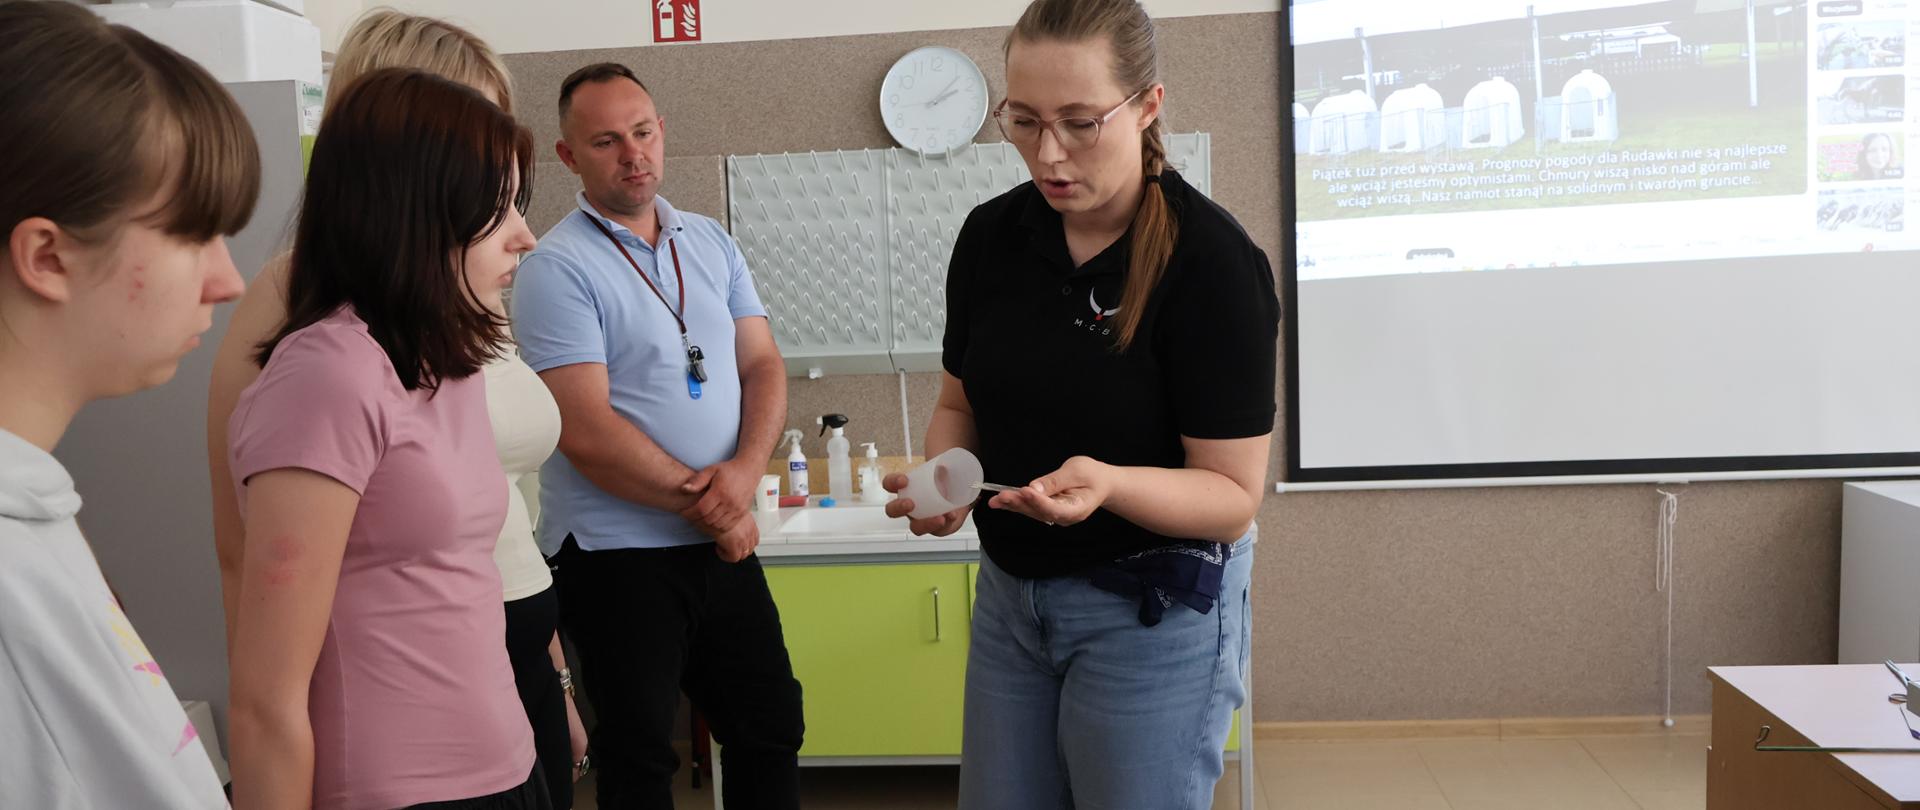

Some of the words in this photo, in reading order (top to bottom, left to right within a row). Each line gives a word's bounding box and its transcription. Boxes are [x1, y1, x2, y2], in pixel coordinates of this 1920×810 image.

[931, 56, 943, 72] 12
[899, 75, 914, 90] 10
[890, 94, 900, 108] 9
[895, 113, 904, 128] 8
[927, 132, 936, 148] 6
[1312, 168, 1353, 182] Piątek
[1380, 163, 1416, 178] przed
[1482, 158, 1541, 171] Prognozy
[1545, 153, 1594, 168] pogody
[1598, 151, 1618, 164] dla
[1622, 148, 1677, 163] Rudawki
[1682, 147, 1702, 158] nie
[1706, 148, 1721, 159] są
[1725, 143, 1787, 158] najlepsze
[1328, 182, 1348, 194] ale
[1351, 180, 1387, 193] wciąż
[1391, 176, 1447, 191] jesteśmy
[1450, 171, 1535, 188] optymistami.
[1538, 169, 1590, 181] Chmury
[1594, 166, 1629, 179] wiszą
[1633, 163, 1667, 176] nisko
[1671, 161, 1696, 174] nad
[1699, 159, 1746, 175] górami
[1751, 158, 1770, 170] ale
[1336, 195, 1372, 208] wciąż
[1455, 188, 1501, 200] namiot
[1547, 185, 1563, 195] na
[1567, 181, 1626, 195] solidnym
[1638, 177, 1697, 191] twardym
